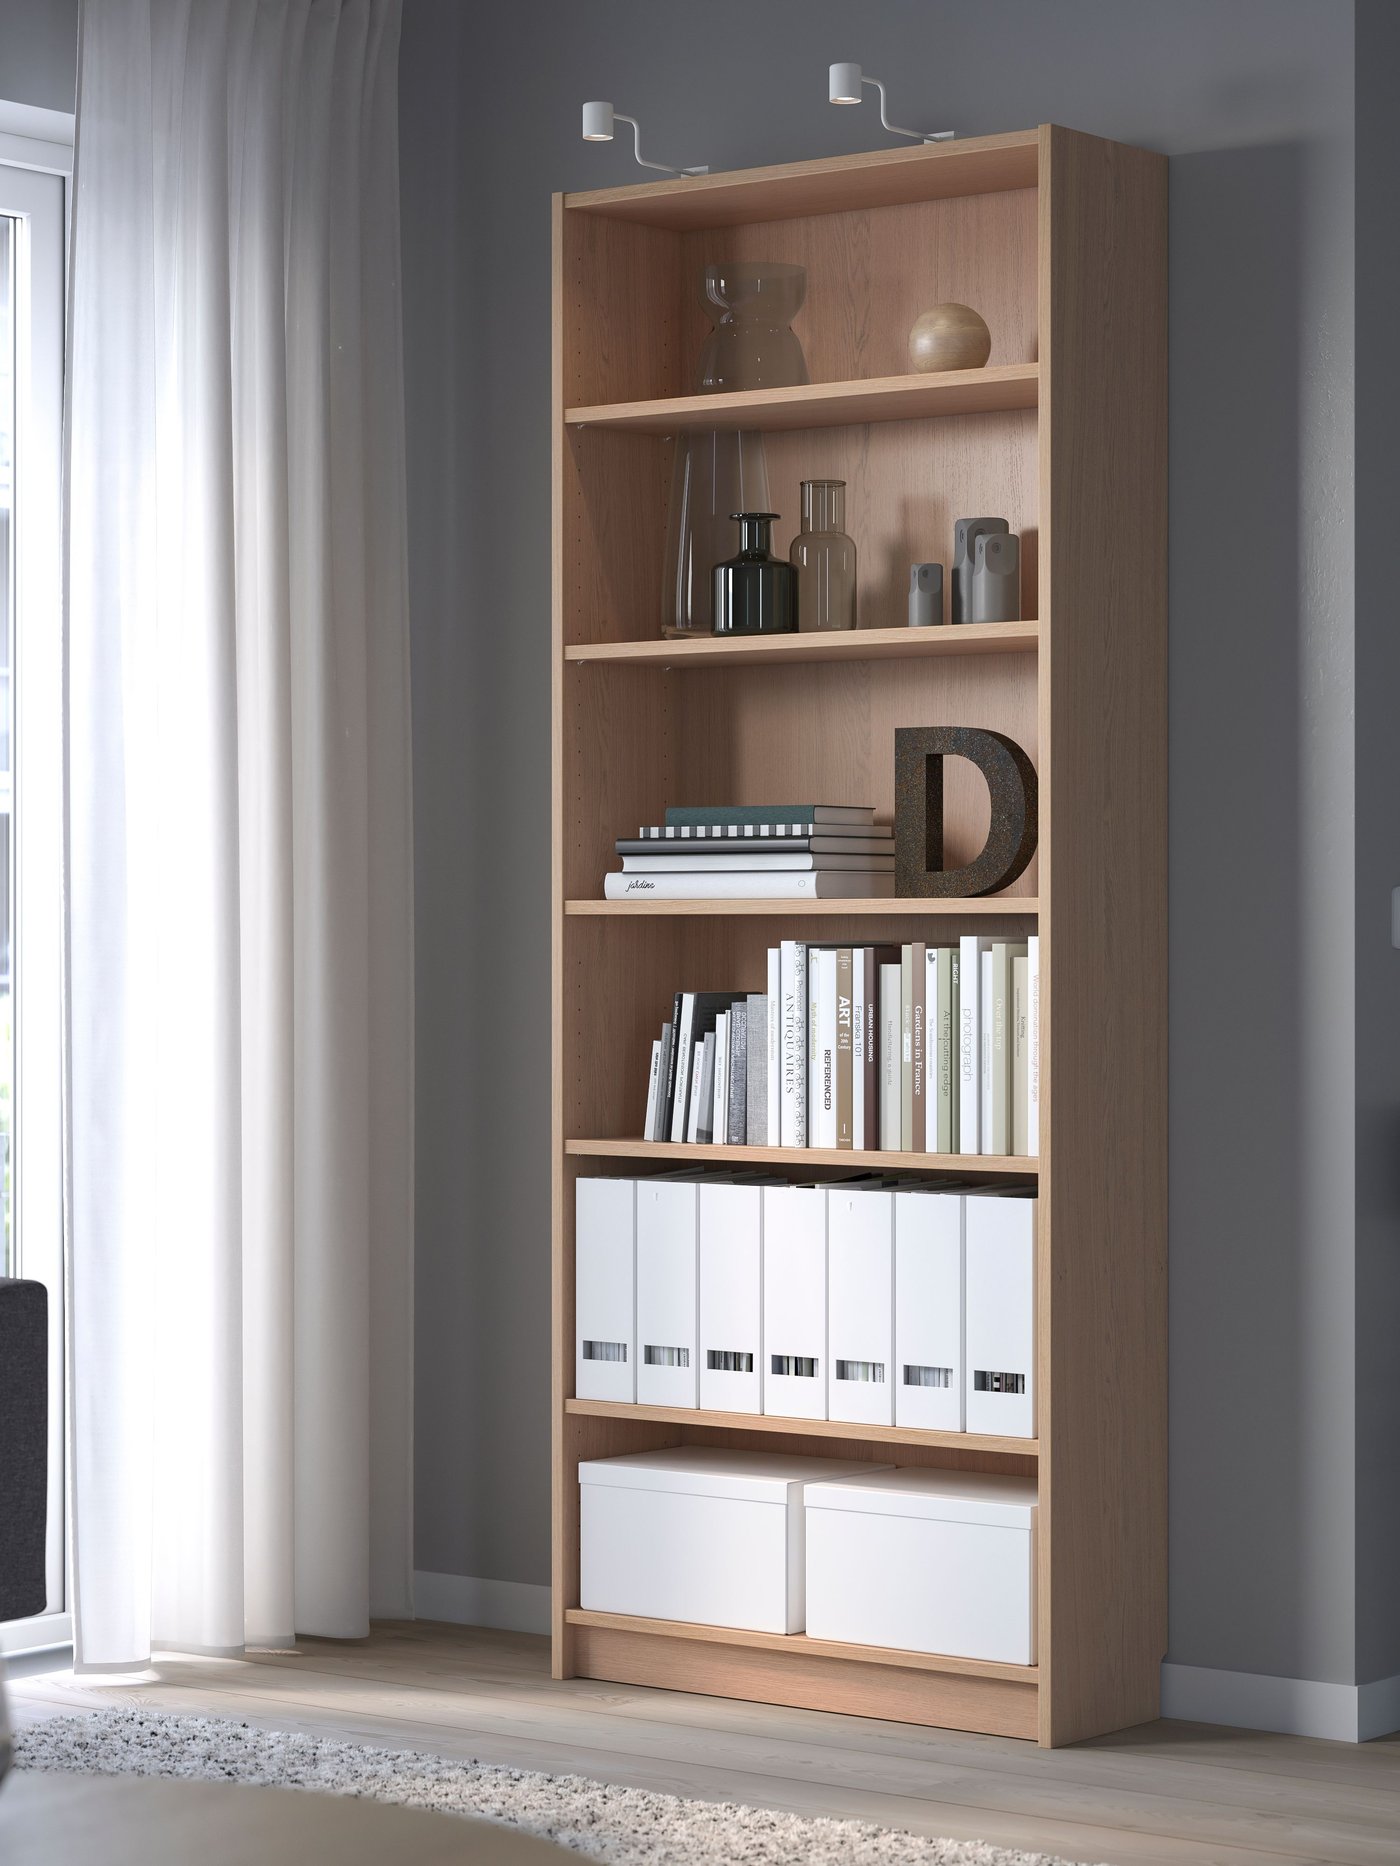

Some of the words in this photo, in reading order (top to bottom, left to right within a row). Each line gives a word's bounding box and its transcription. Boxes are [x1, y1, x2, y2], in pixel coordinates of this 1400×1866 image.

[895, 726, 1039, 898] D
[1032, 974, 1040, 997] World
[810, 1002, 818, 1018] Myth
[838, 995, 851, 1027] ART
[943, 1010, 951, 1022] At
[995, 998, 1004, 1019] Over
[1032, 998, 1040, 1040] domination
[915, 1005, 923, 1047] Gardens
[943, 1023, 951, 1037] the
[995, 1021, 1004, 1034] the
[784, 993, 795, 1095] ANTIQUAIRES
[810, 1027, 818, 1061] modernity
[915, 1049, 923, 1060] in
[941, 1041, 950, 1071] cutting
[961, 1008, 974, 1082] photograph
[1031, 1041, 1040, 1070] through
[823, 1049, 832, 1111] REFERENCED
[915, 1061, 923, 1096] France
[941, 1073, 950, 1097] edge
[1032, 1072, 1040, 1084] the
[1031, 1085, 1039, 1102] ages
